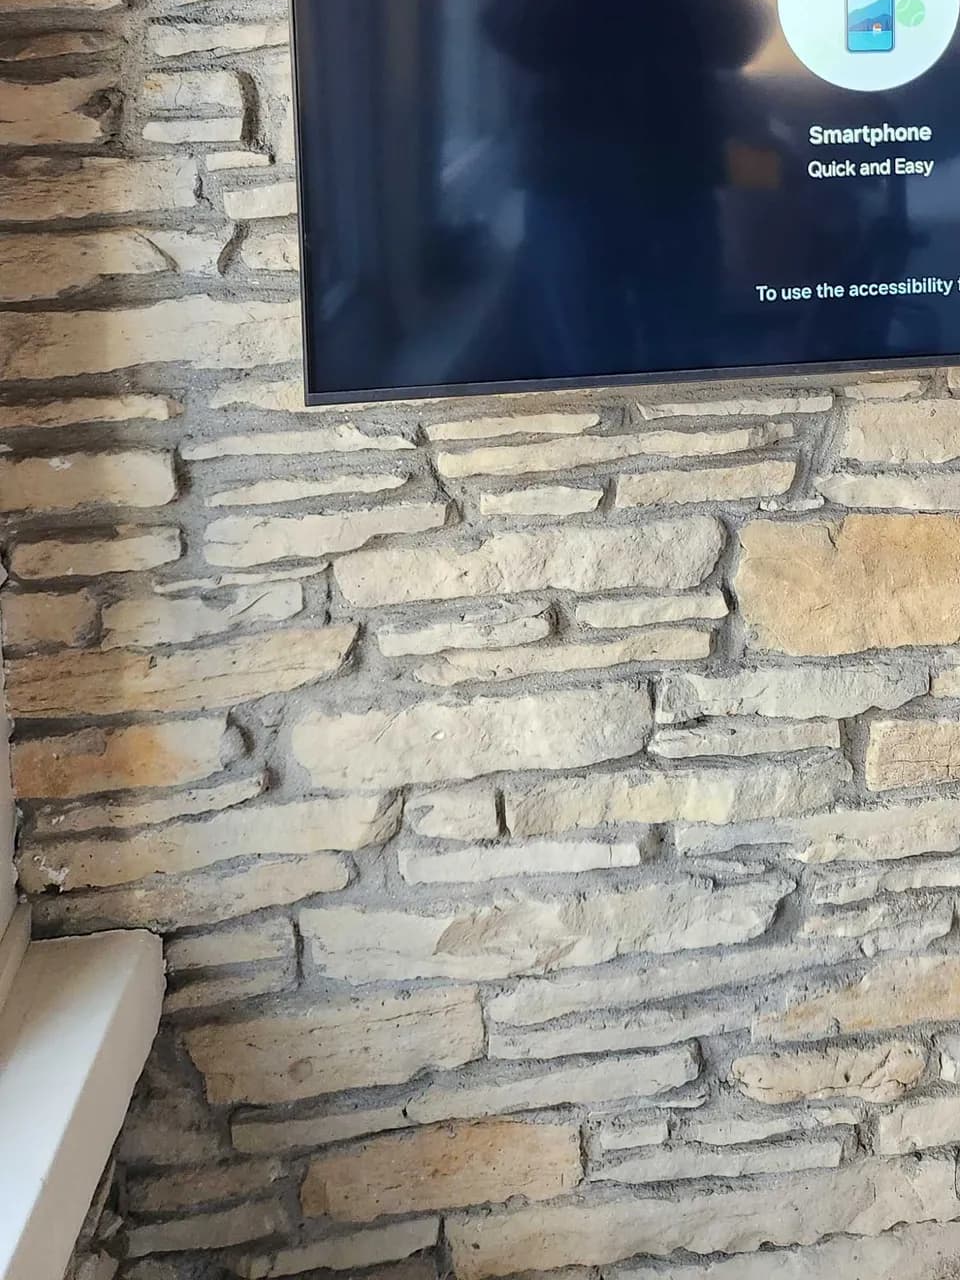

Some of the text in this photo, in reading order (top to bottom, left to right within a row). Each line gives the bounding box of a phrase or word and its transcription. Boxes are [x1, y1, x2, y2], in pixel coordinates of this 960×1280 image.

[809, 122, 932, 147] Smartphone
[807, 157, 935, 179] Quick and Easy
[755, 285, 778, 302] To
[781, 286, 813, 301] use
[815, 282, 845, 299] the
[848, 277, 954, 297] accessibility
